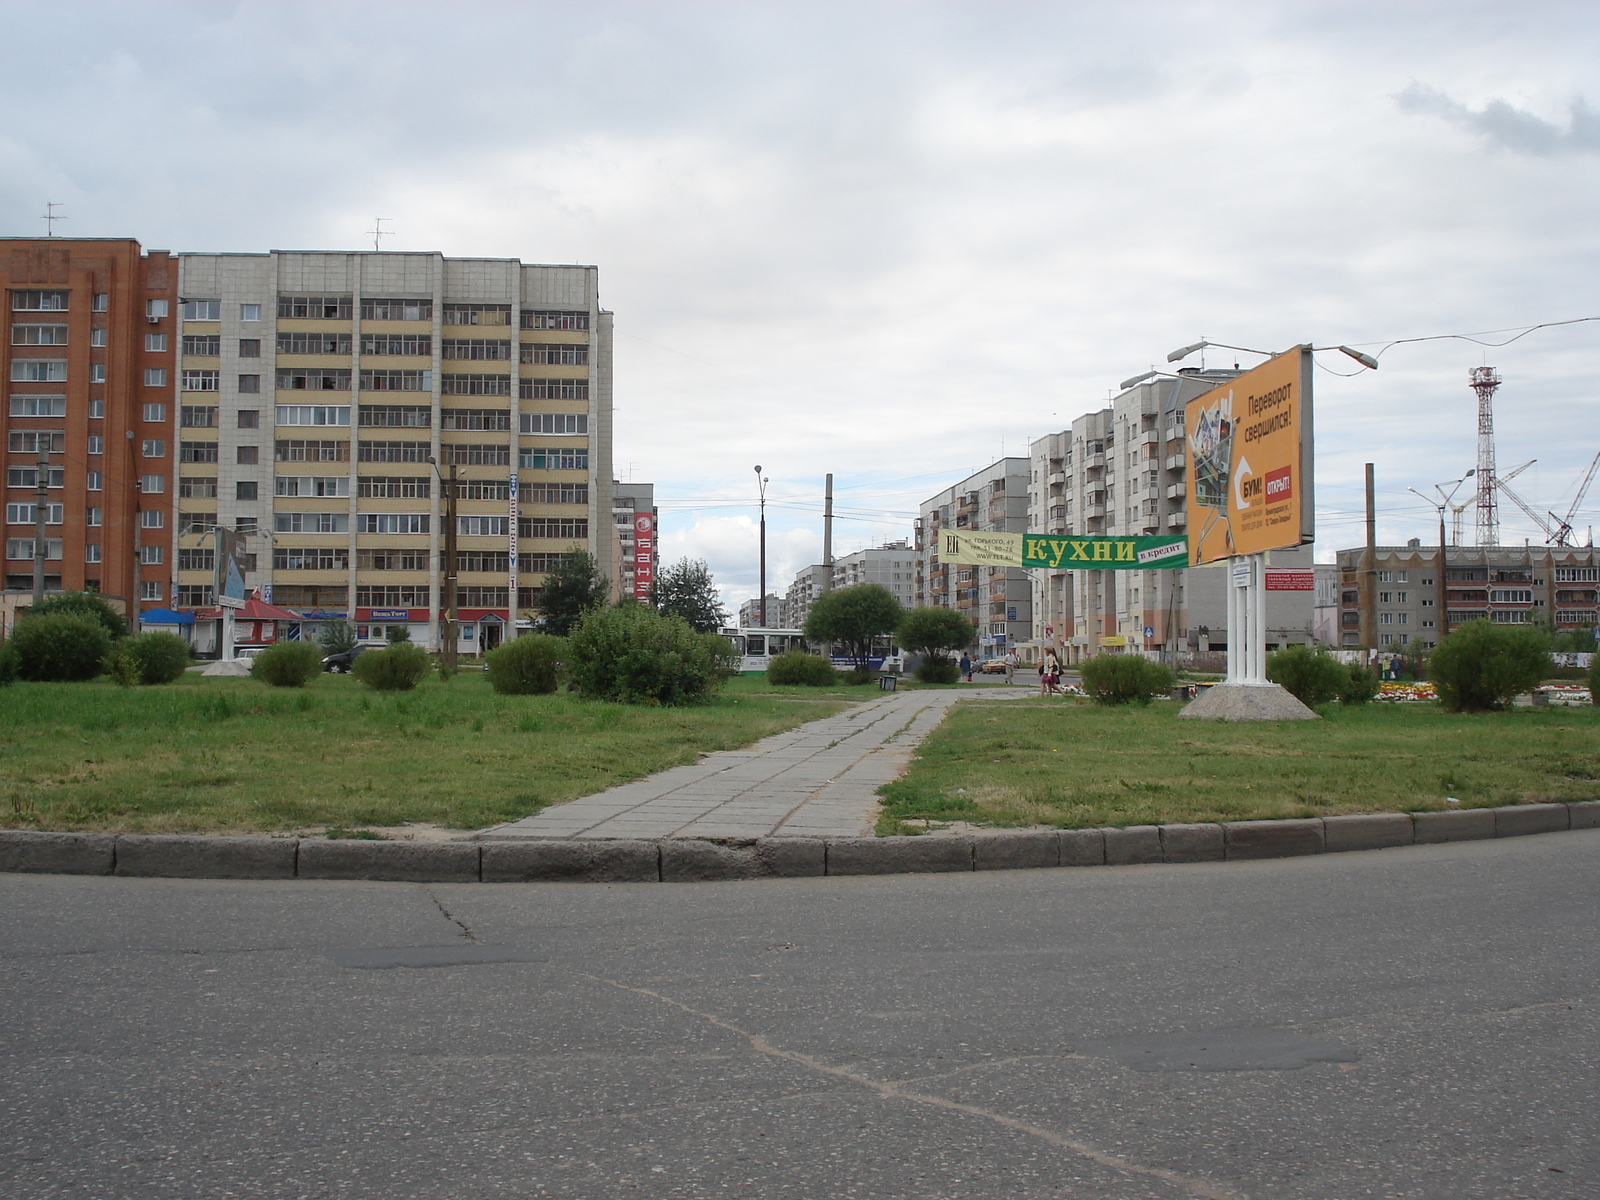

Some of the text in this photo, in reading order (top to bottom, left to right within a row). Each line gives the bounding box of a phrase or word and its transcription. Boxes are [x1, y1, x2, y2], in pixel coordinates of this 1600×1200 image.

[1249, 382, 1292, 417] Переворот
[1244, 404, 1292, 443] свершился!
[1242, 475, 1290, 498] БУМ! ОТКРЫТ!
[1026, 539, 1136, 568] КУХНИ
[1148, 543, 1181, 559] кредит
